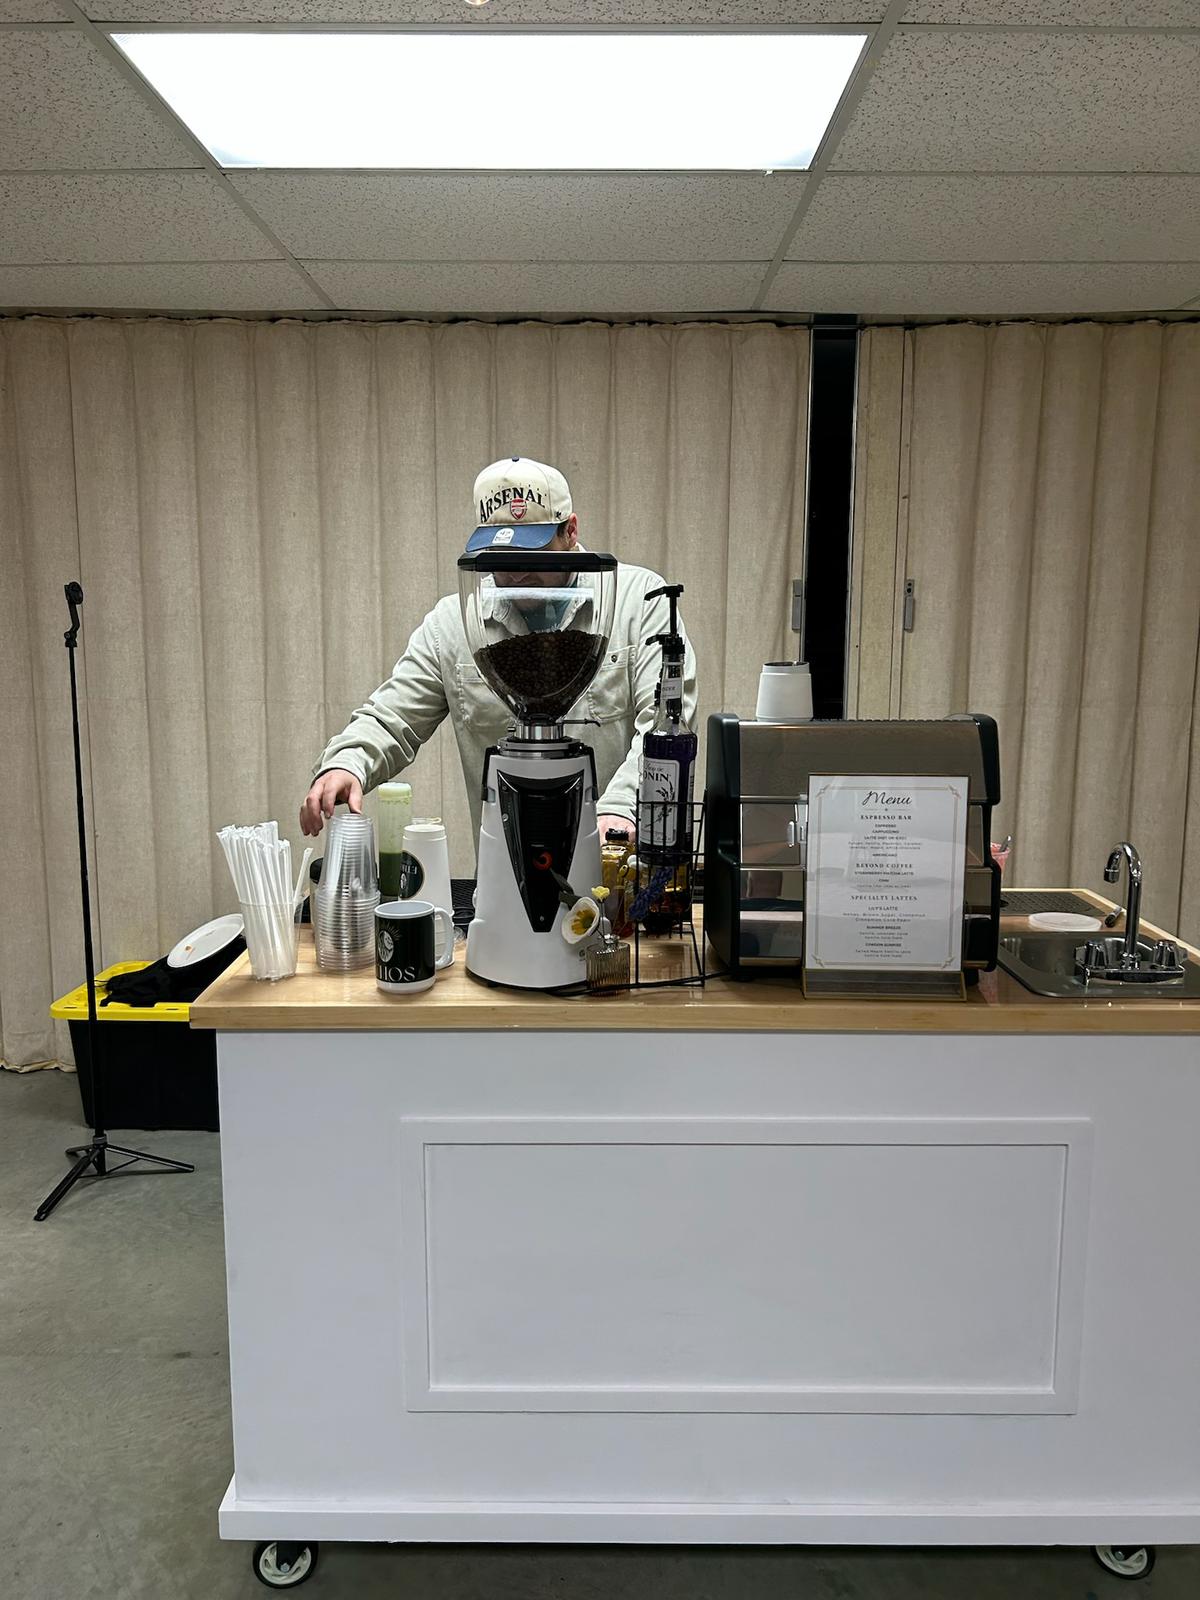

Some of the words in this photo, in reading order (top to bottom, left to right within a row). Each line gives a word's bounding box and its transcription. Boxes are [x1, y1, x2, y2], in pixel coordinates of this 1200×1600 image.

[480, 487, 546, 523] ARSENAL
[643, 770, 669, 783] ONIN
[861, 790, 912, 806] Menu
